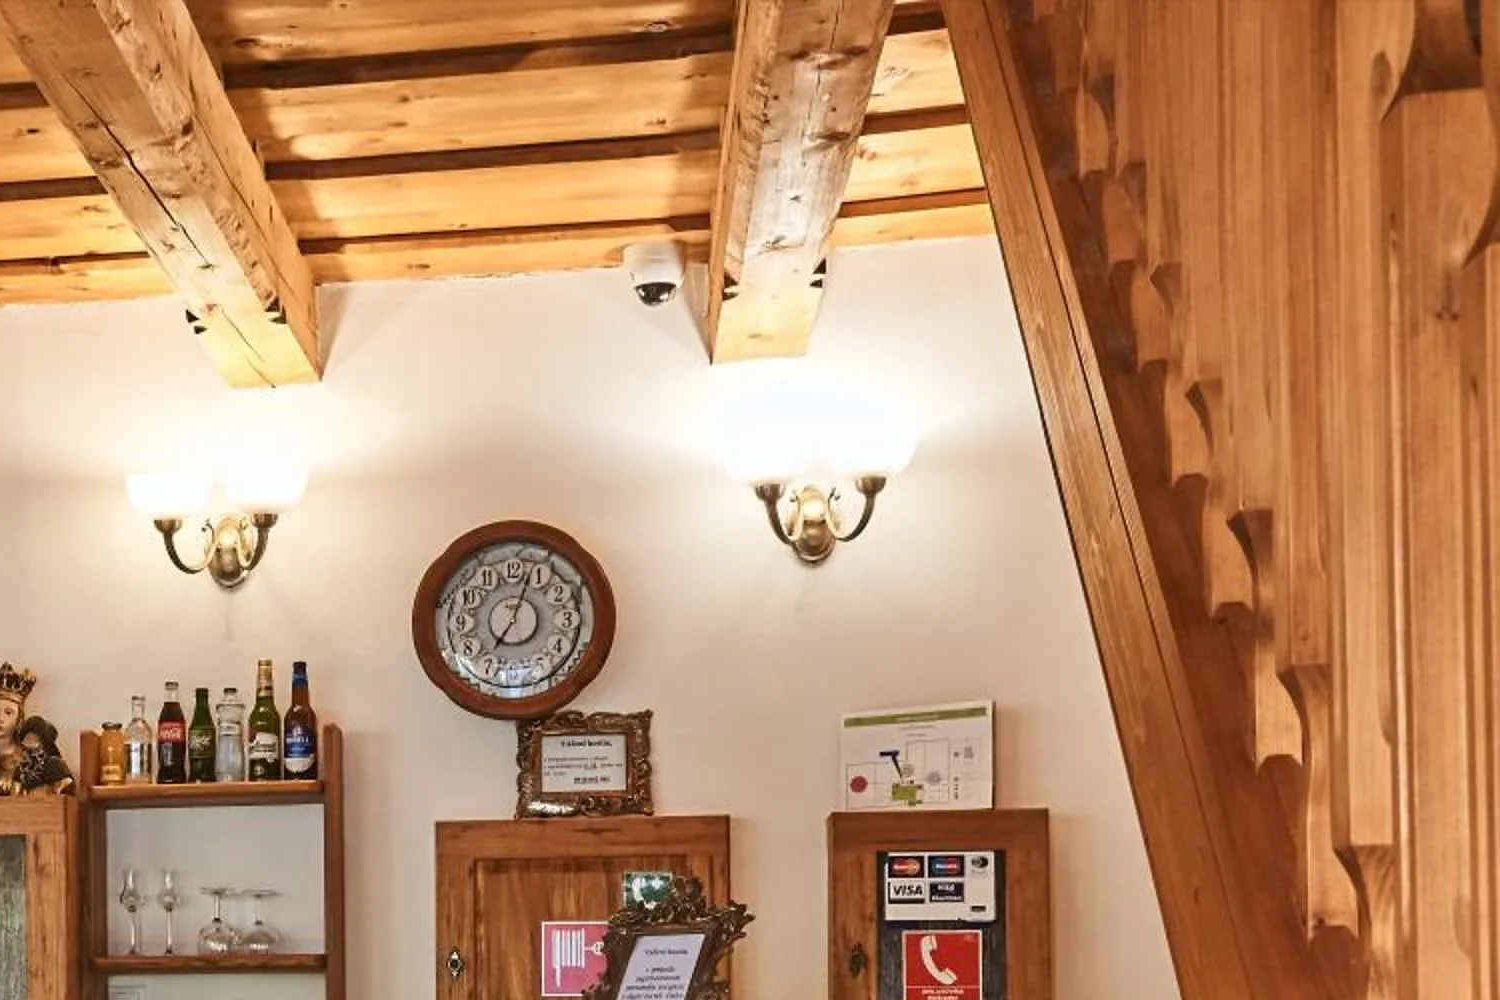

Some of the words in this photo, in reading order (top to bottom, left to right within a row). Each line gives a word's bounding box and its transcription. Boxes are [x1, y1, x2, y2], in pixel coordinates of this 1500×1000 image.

[482, 569, 492, 587] 11
[507, 562, 521, 579] 12
[536, 567, 541, 585] 1
[463, 588, 475, 606] 10
[554, 585, 563, 602] 2
[455, 615, 465, 633] 9
[562, 611, 573, 628] 3
[462, 639, 473, 657] 8
[553, 638, 562, 654] 4
[483, 656, 493, 675] 7
[893, 885, 923, 896] VISA
